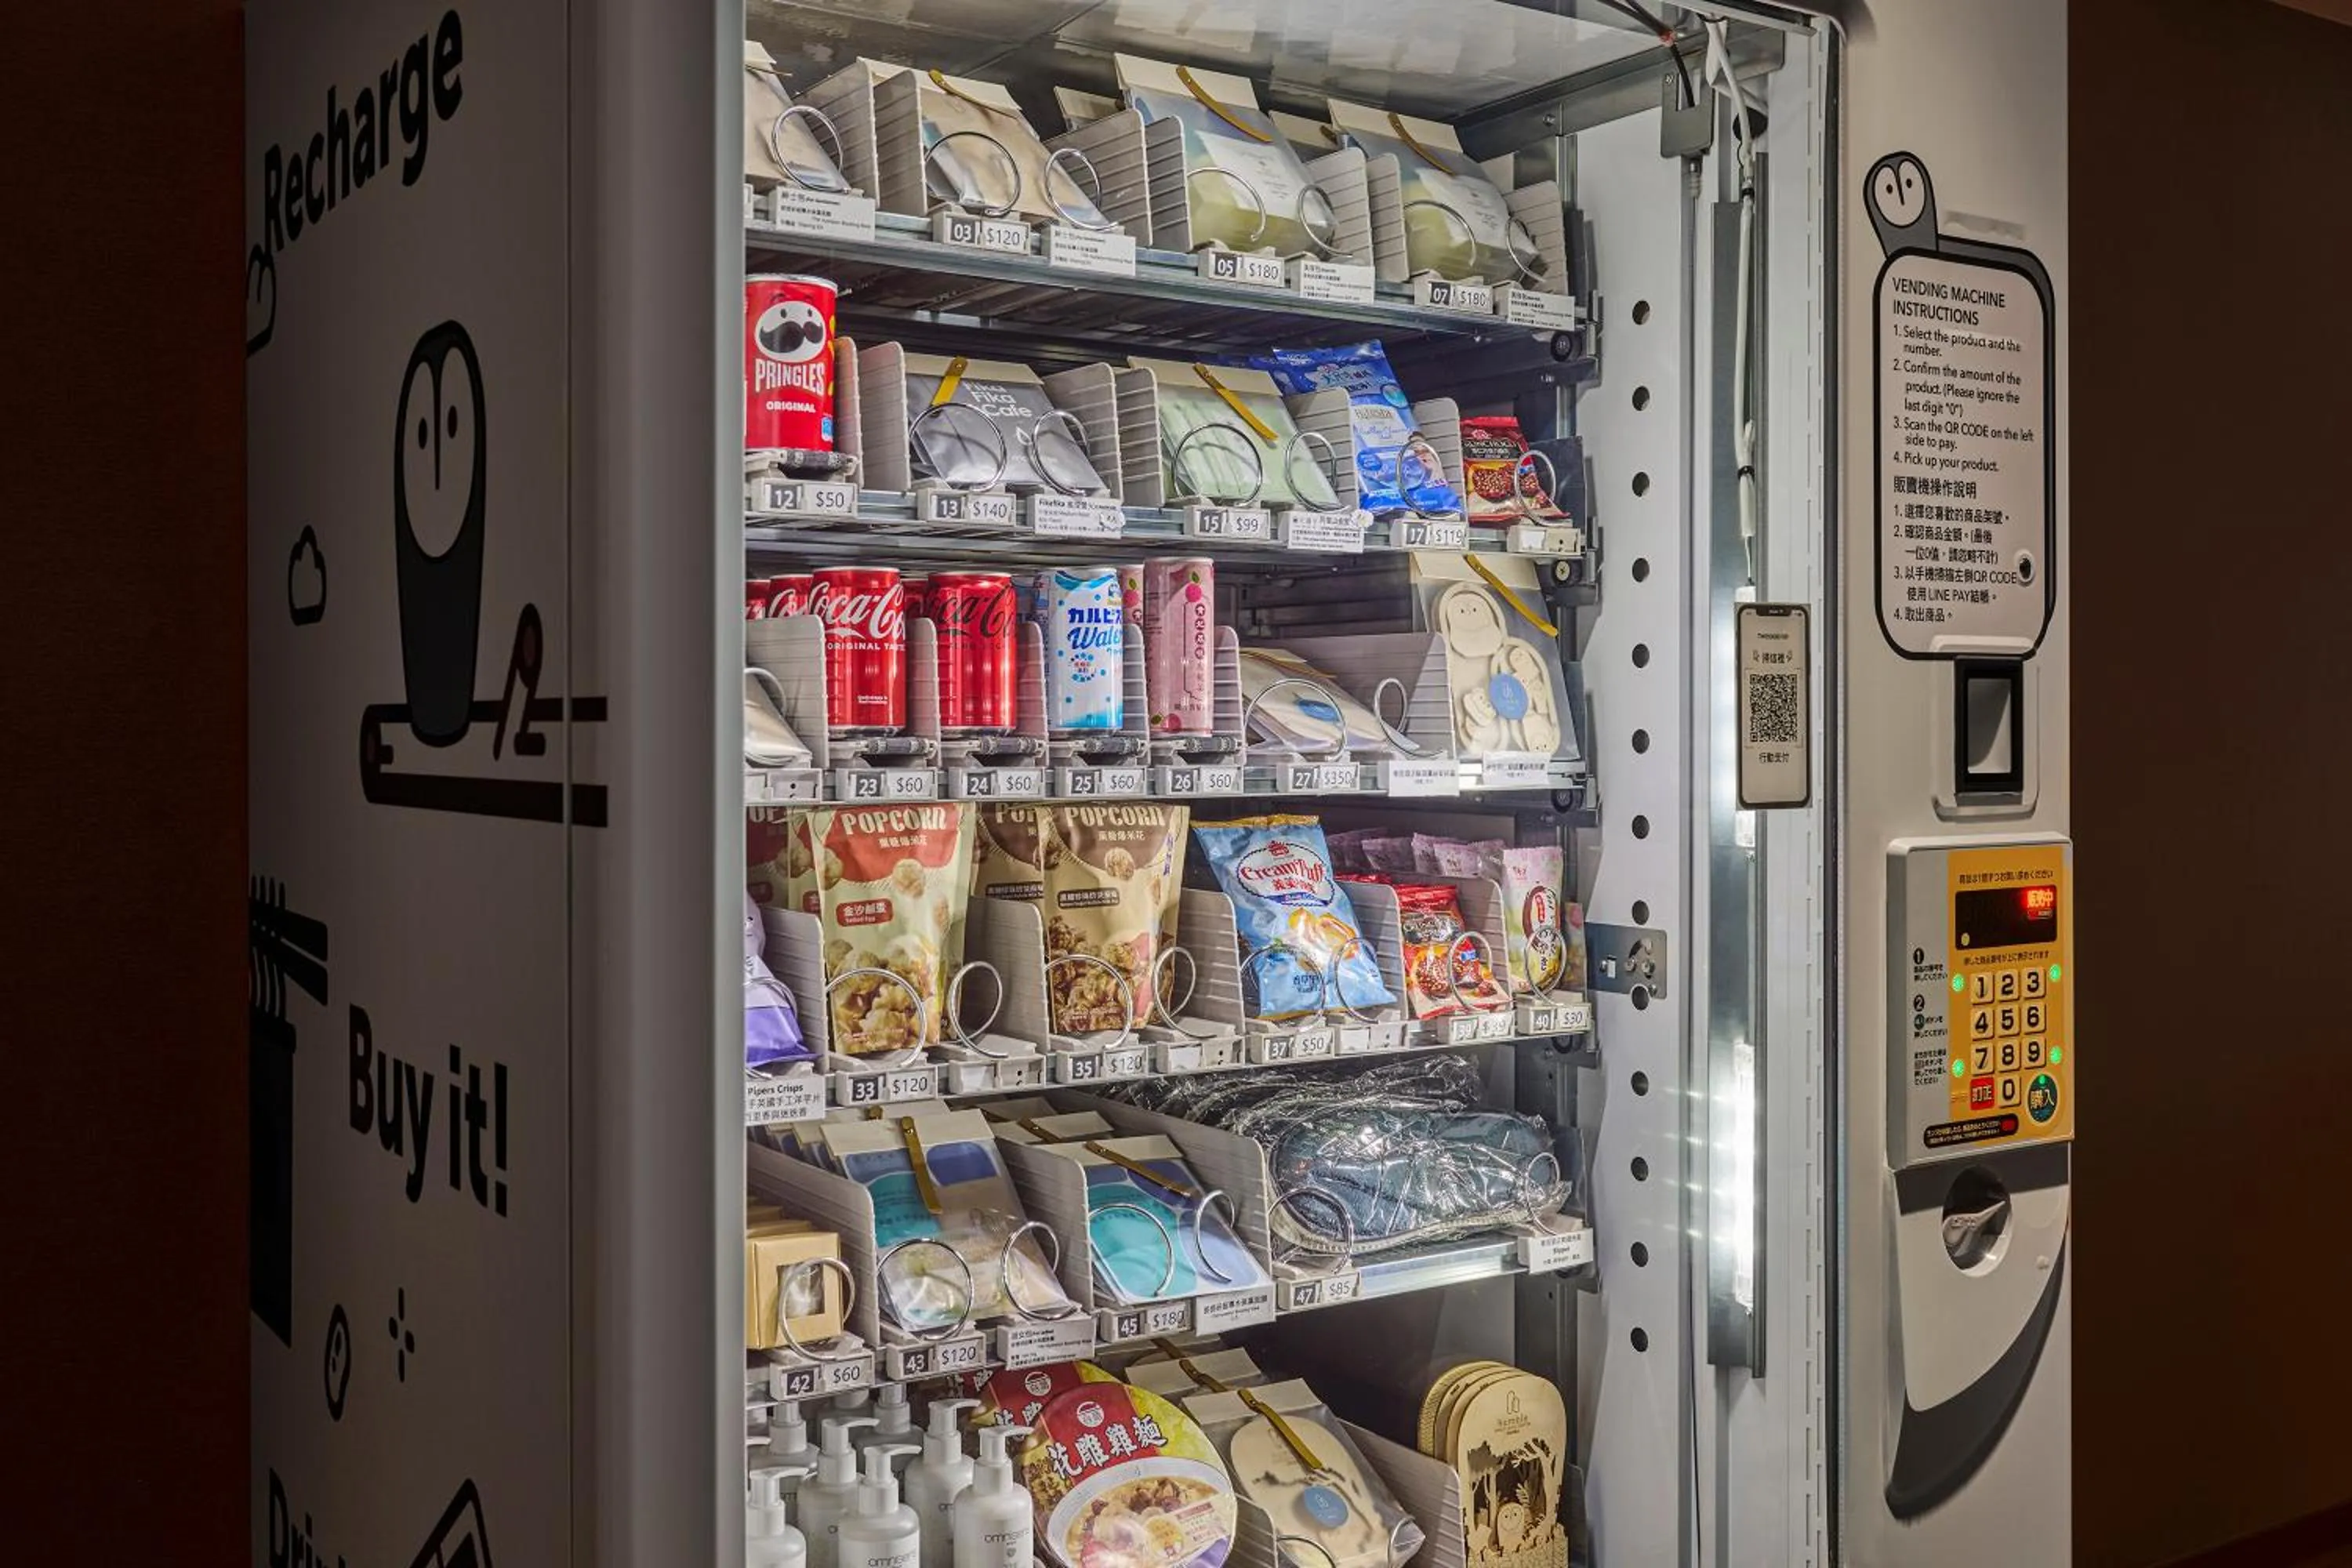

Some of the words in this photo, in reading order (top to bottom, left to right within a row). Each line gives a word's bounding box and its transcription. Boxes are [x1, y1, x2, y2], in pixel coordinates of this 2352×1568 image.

[265, 9, 463, 252] Recharge
[953, 223, 972, 241] 03
[986, 227, 1021, 245] $120
[1217, 259, 1234, 274] 05
[1249, 263, 1279, 280] $180
[1432, 287, 1448, 303] 07
[1460, 291, 1486, 307] $180
[1892, 277, 1948, 299] VENDING
[1951, 286, 2006, 308] MACHINE
[1893, 299, 1980, 325] INSTRUCTIONS
[1893, 324, 1902, 337] 1.
[1904, 325, 1933, 341] Select
[1934, 329, 1948, 343] the
[1951, 333, 1986, 347] product
[1987, 338, 2005, 351] and
[2006, 339, 2021, 352] the
[1904, 343, 1943, 358] number.
[754, 359, 826, 396] PRINGLES
[1893, 358, 1901, 371] 2.
[1904, 360, 1940, 376] Confirm
[1942, 365, 1958, 378] the
[1959, 369, 1994, 383] amount
[1995, 371, 2005, 383] of
[2006, 372, 2021, 386] the
[972, 392, 1017, 404] Fika
[1905, 381, 1942, 394] product.
[1944, 383, 1975, 398] (Please
[1976, 388, 2004, 404] ignore
[2005, 391, 2020, 404] the
[766, 400, 816, 413] ORIGINAL
[980, 404, 1033, 418] Cafe
[1904, 397, 1920, 412] last
[1922, 401, 1944, 416] digit
[1893, 416, 1902, 430] 3.
[1904, 417, 1926, 431] Scan
[1927, 419, 1943, 433] the
[1944, 421, 1959, 435] QR
[1961, 423, 1989, 438] CODE
[1991, 429, 2003, 439] on
[2004, 428, 2019, 441] the
[2020, 429, 2034, 442] left
[1905, 434, 1925, 447] side
[1926, 436, 1936, 448] to
[1939, 439, 1958, 452] pay.
[1893, 451, 1903, 464] 4.
[1904, 451, 1922, 465] Pick
[1925, 456, 1937, 470] up
[1939, 459, 1960, 470] your
[1962, 459, 1999, 472] product.
[774, 488, 794, 508] 12
[815, 489, 845, 510] $50
[940, 499, 958, 517] 13
[972, 501, 1007, 519] $140
[1894, 504, 1903, 517] 1.
[1203, 515, 1219, 532] 15
[1236, 517, 1258, 532] $99
[1893, 524, 1903, 538] 2.
[1436, 528, 1463, 545] $119
[1893, 566, 1902, 579] 3.
[1989, 570, 2017, 584] CODE
[1893, 608, 1903, 620] 4.
[858, 778, 877, 795] 23
[896, 776, 923, 793] $60
[969, 776, 989, 793] 24
[1006, 775, 1032, 792] $60
[1074, 775, 1091, 793] 25
[1110, 774, 1134, 790] $60
[1174, 774, 1192, 790] 26
[1208, 773, 1232, 789] $60
[1295, 772, 1312, 787] 27
[840, 807, 946, 835] POPCORN
[1065, 806, 1166, 827] POPCORN
[1240, 862, 1295, 880] Cream
[1975, 977, 1985, 998] 1
[2001, 974, 2014, 996] 2
[2027, 971, 2039, 993] 3
[1536, 1013, 1548, 1029] 40
[1975, 1012, 1988, 1033] 4
[2001, 1009, 2014, 1030] 5
[2027, 1006, 2039, 1028] 6
[1272, 1041, 1287, 1057] 37
[1301, 1037, 1324, 1051] $50
[1975, 1048, 1988, 1069] 7
[2002, 1044, 2015, 1066] 8
[2027, 1041, 2040, 1063] 9
[1076, 1060, 1093, 1076] 35
[1110, 1054, 1142, 1073] $120
[747, 1086, 775, 1095] Pipers
[777, 1083, 804, 1094] Crisps
[856, 1081, 875, 1099] 33
[892, 1077, 927, 1094] $120
[1972, 1085, 1992, 1102] 訂正
[2002, 1079, 2015, 1101] 0
[349, 1003, 434, 1203] Buy
[449, 1044, 507, 1218] it!
[1296, 1288, 1313, 1304] 47
[1330, 1280, 1350, 1296] $85
[1120, 1318, 1138, 1335] 45
[906, 1353, 925, 1372] 43
[942, 1345, 976, 1363] $120
[790, 1374, 811, 1394] 42
[833, 1363, 860, 1385] $60
[269, 1467, 347, 1568] Dri
